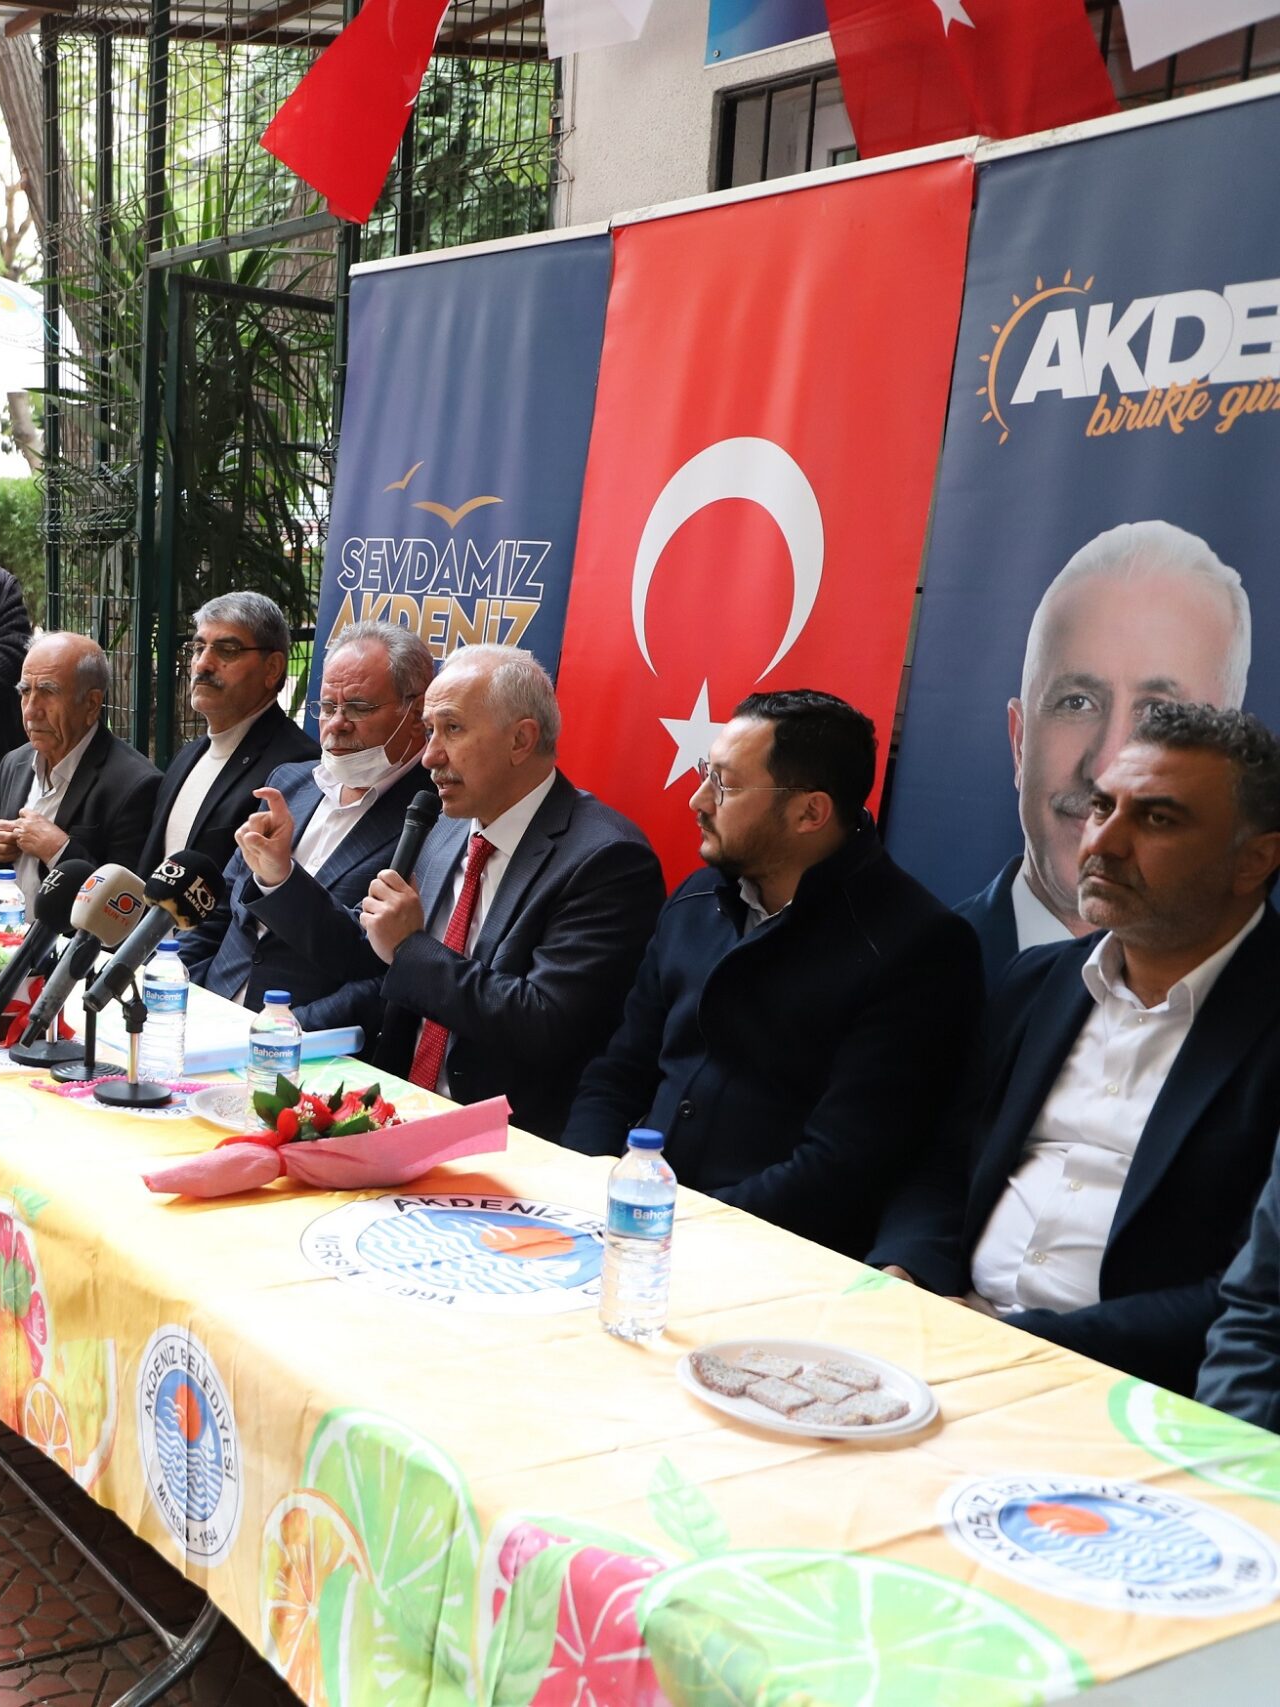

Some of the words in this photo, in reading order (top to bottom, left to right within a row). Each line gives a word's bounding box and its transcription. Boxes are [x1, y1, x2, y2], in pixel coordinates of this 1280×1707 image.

[1086, 378, 1212, 437] birlikte
[337, 537, 552, 600] SEVDAMIZ
[393, 1196, 571, 1222] AKDENİZ
[385, 1284, 456, 1305] 1994
[144, 1343, 178, 1419] AKDENİZ
[181, 1346, 237, 1484] BELEDİYESİ
[156, 1482, 190, 1543] MERSİN
